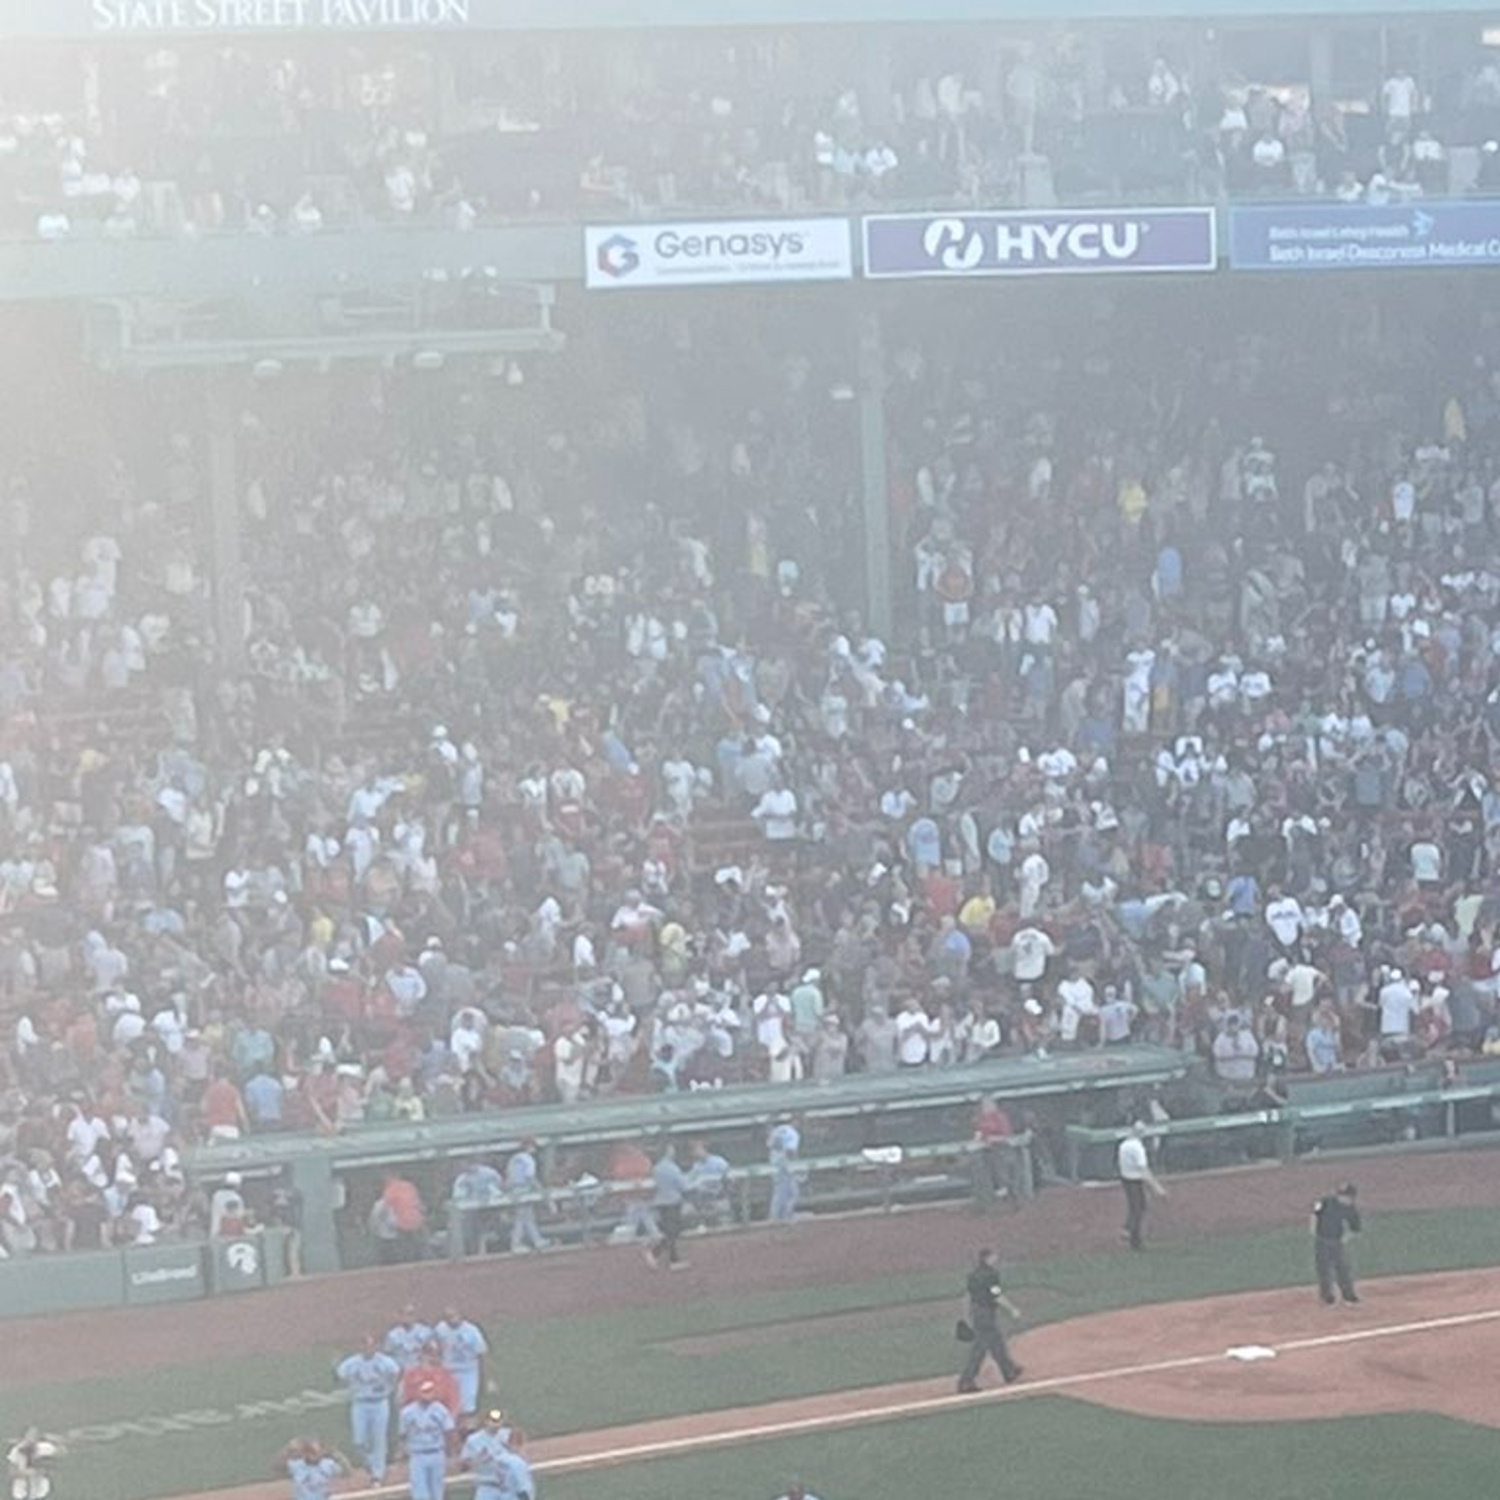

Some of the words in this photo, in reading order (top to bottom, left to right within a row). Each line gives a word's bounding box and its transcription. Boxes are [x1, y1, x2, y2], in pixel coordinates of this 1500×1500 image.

[93, 0, 187, 29] STATE
[196, 0, 308, 27] STREET
[319, 0, 471, 26] PAVILION
[654, 231, 804, 259] Genasys
[997, 222, 1139, 262] HYCU
[1429, 240, 1485, 258] Medical
